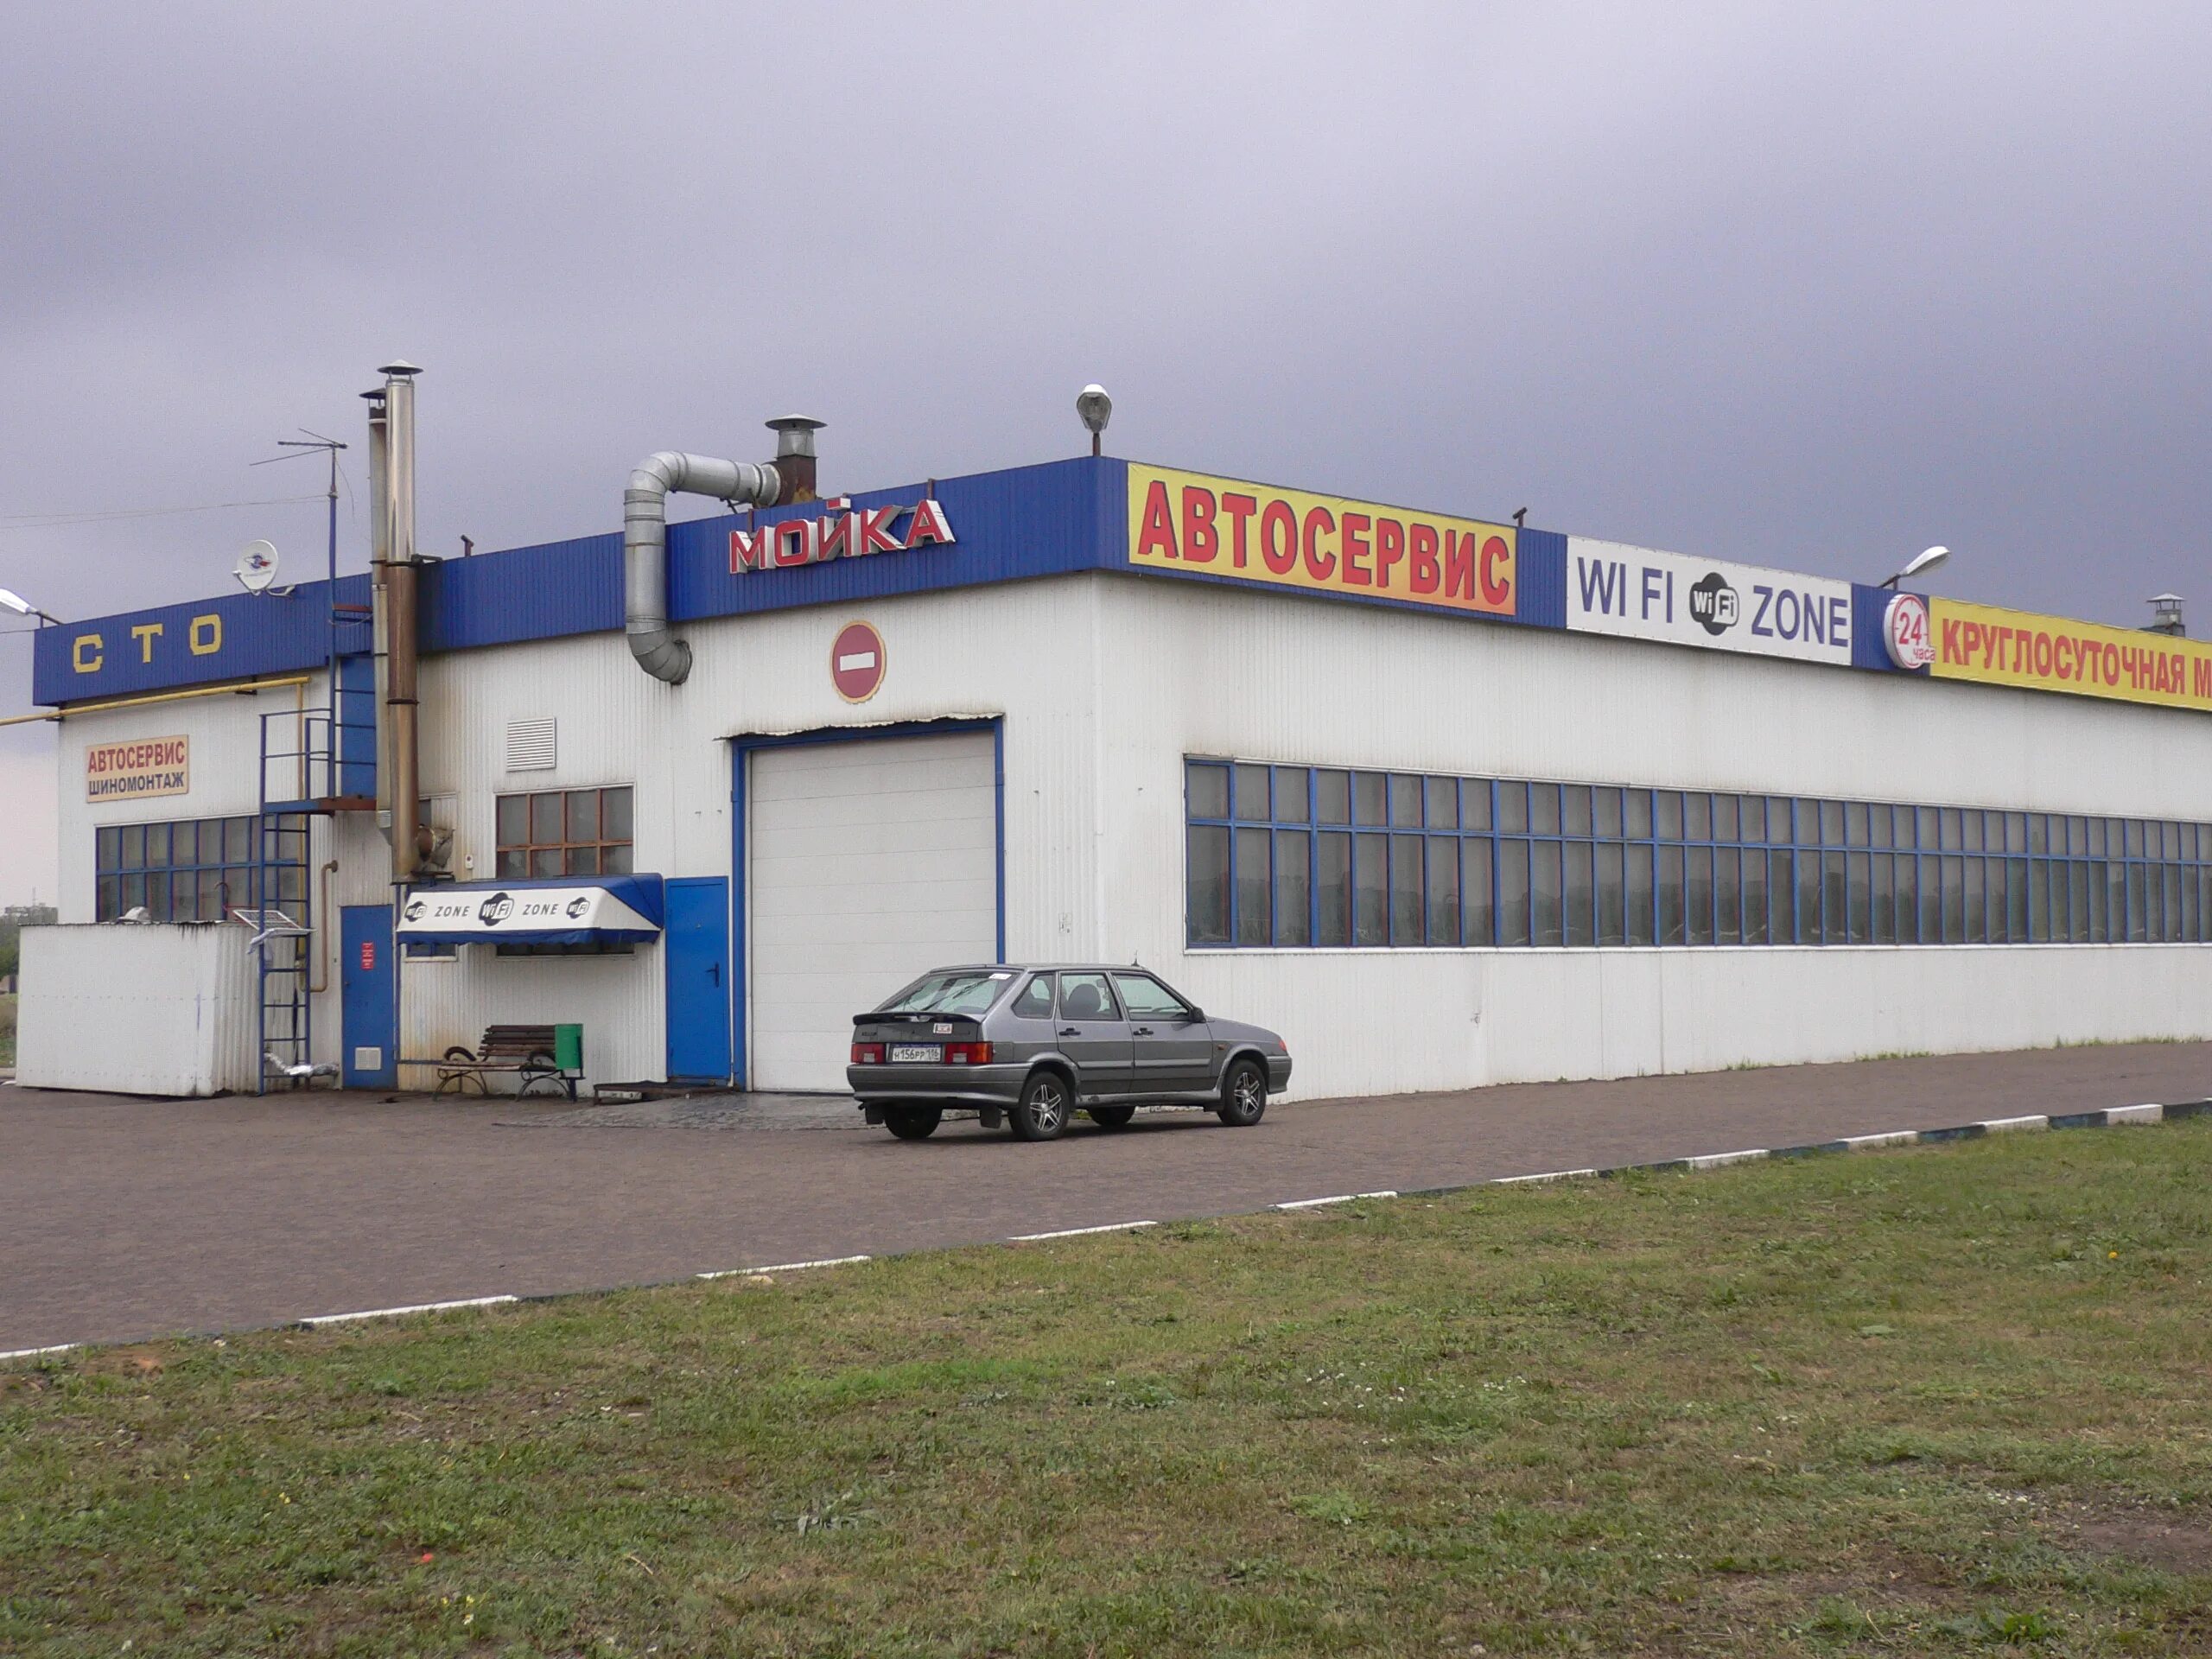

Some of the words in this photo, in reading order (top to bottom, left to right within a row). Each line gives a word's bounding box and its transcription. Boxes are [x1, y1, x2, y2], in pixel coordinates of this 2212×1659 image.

[729, 498, 956, 575] МОЙКА
[1137, 480, 1510, 606] АВТОСЕРВИС
[1577, 556, 1626, 618] WI
[1642, 566, 1674, 624] FI
[1751, 585, 1850, 647] ZONE
[1898, 612, 1923, 645] 24
[1912, 647, 1936, 661] часа
[1942, 617, 2186, 696] КРУГЛОСУТОЧНАЯ
[88, 741, 185, 773] АВТОСЕРВИС
[88, 772, 184, 796] ШИНОМОНТАЖ
[434, 906, 470, 918] ZONE
[522, 903, 558, 916] ZONE
